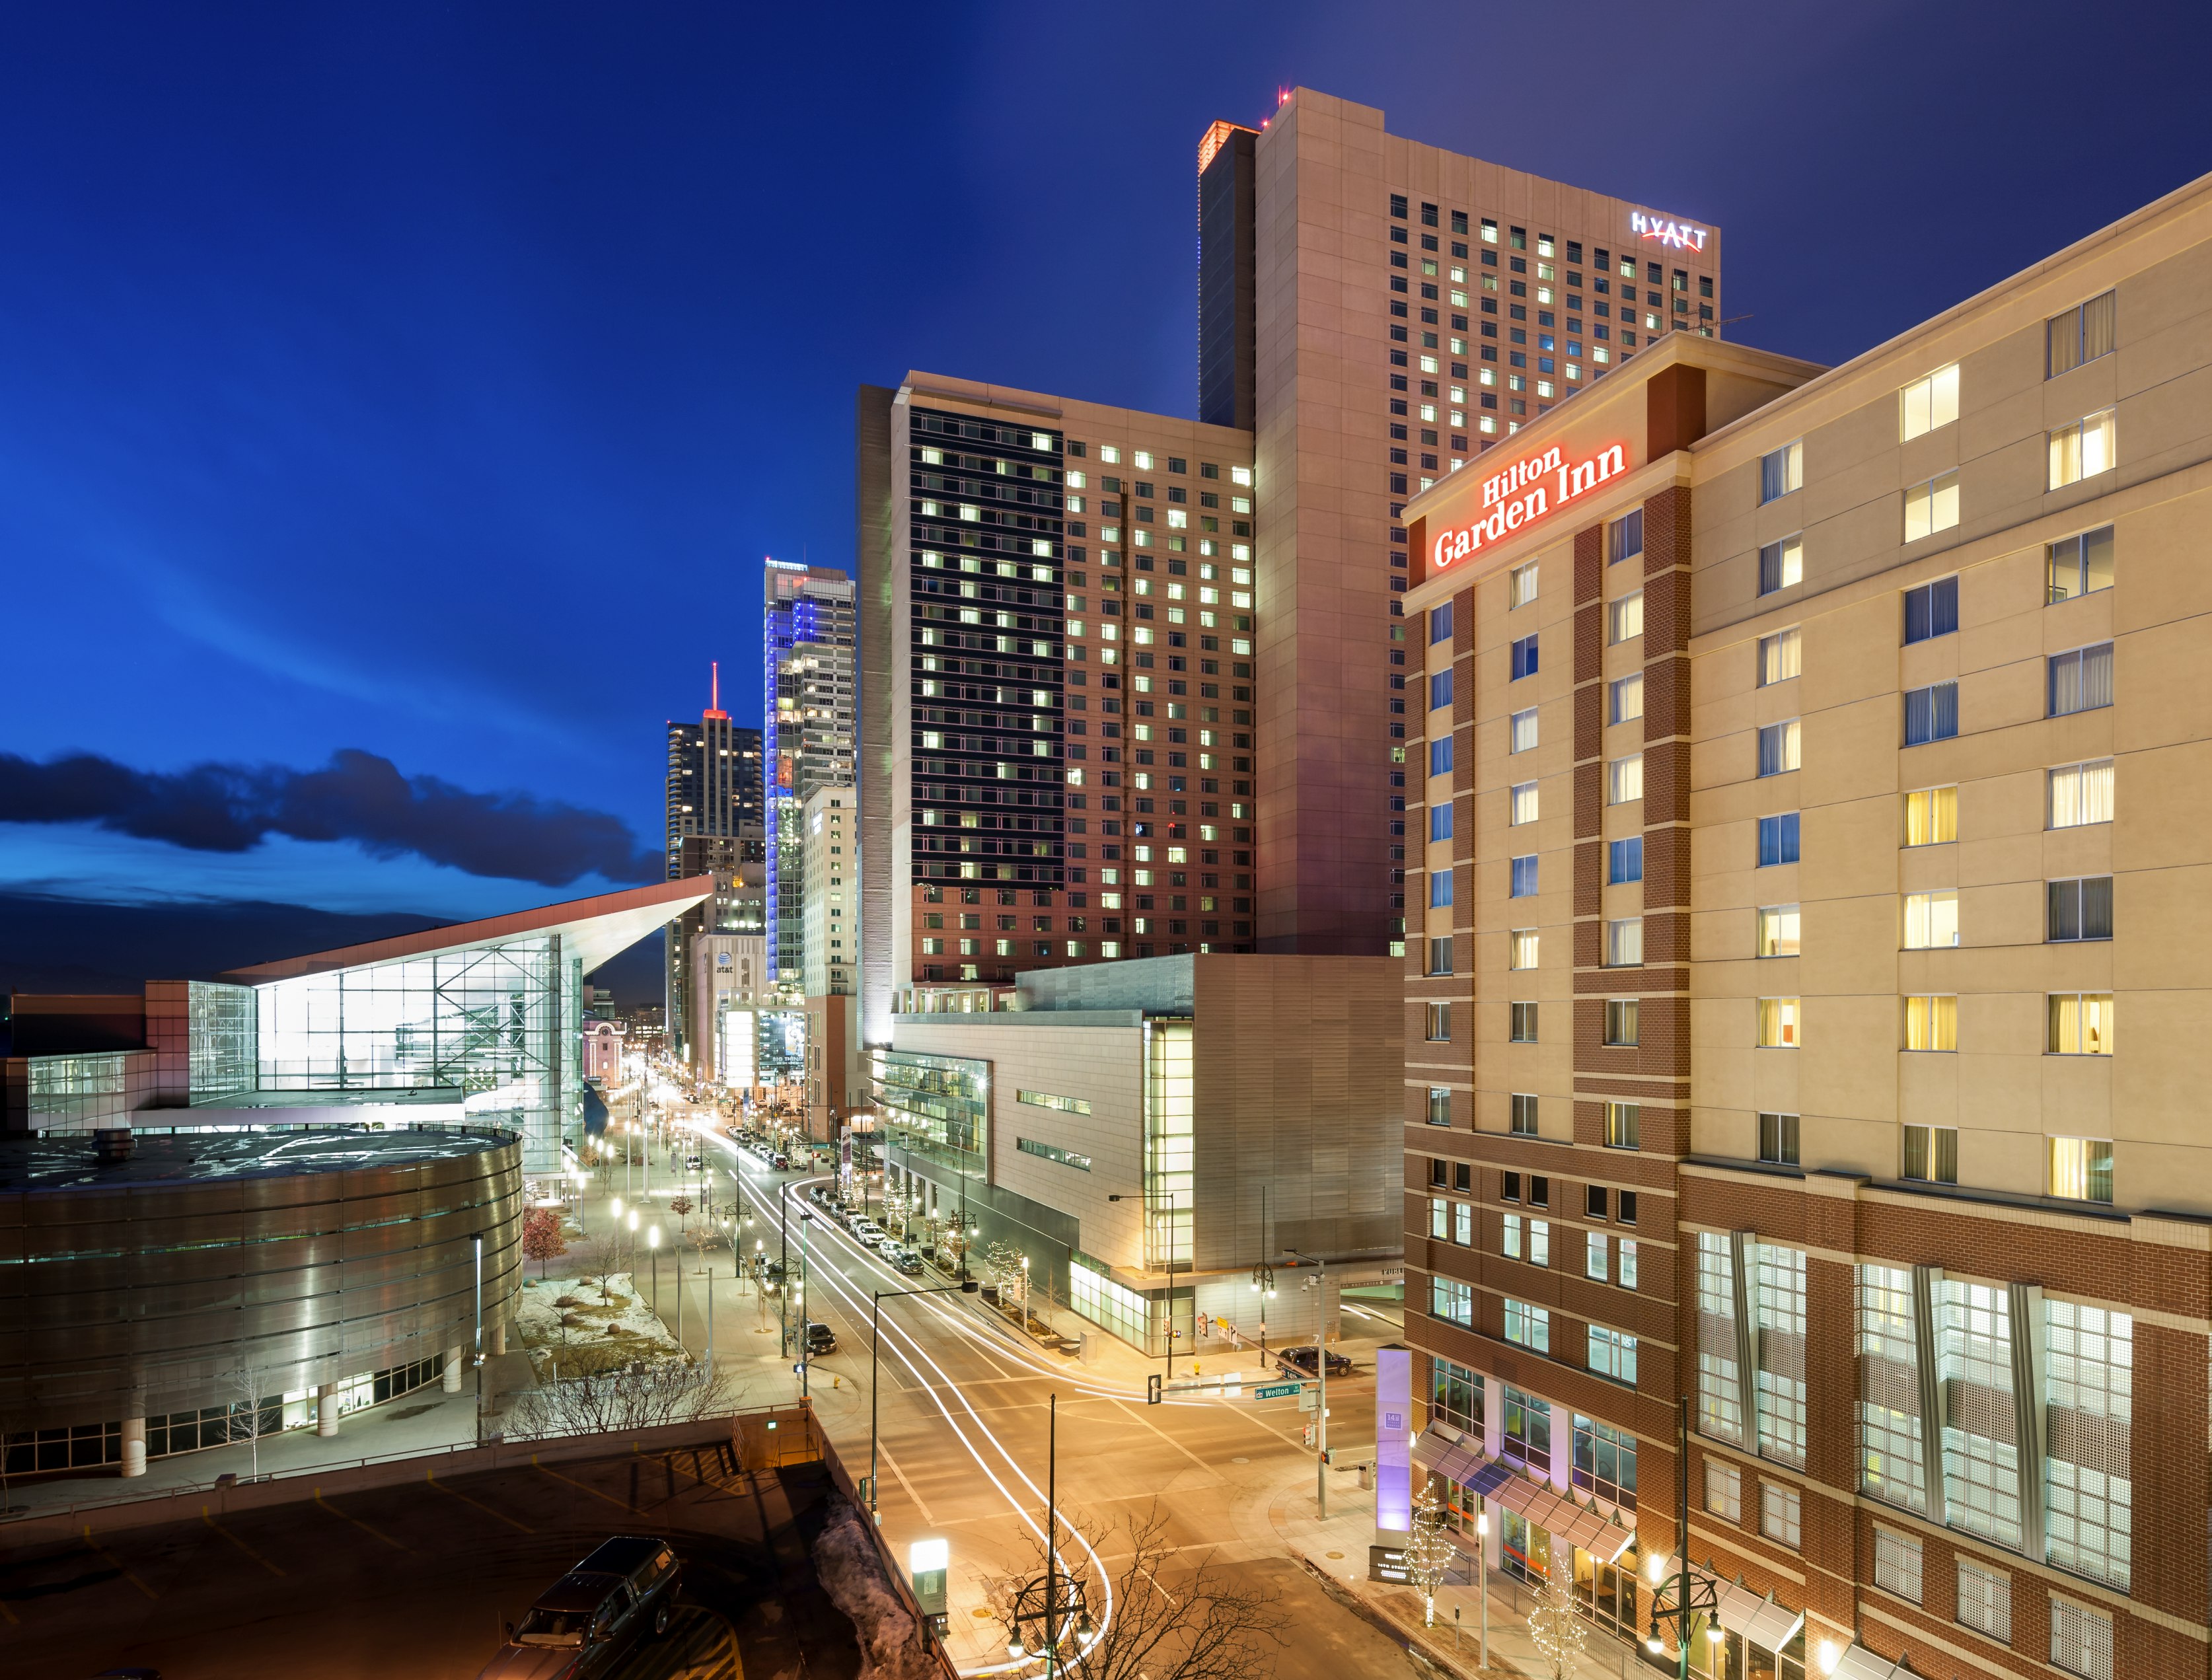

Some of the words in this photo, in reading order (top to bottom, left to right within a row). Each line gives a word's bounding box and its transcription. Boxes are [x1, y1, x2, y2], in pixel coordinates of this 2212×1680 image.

[1632, 212, 1707, 249] HYATT
[1482, 446, 1562, 509] Hilton
[1434, 486, 1548, 567] Garden
[1556, 444, 1625, 505] Inn
[1265, 1387, 1289, 1397] Welton
